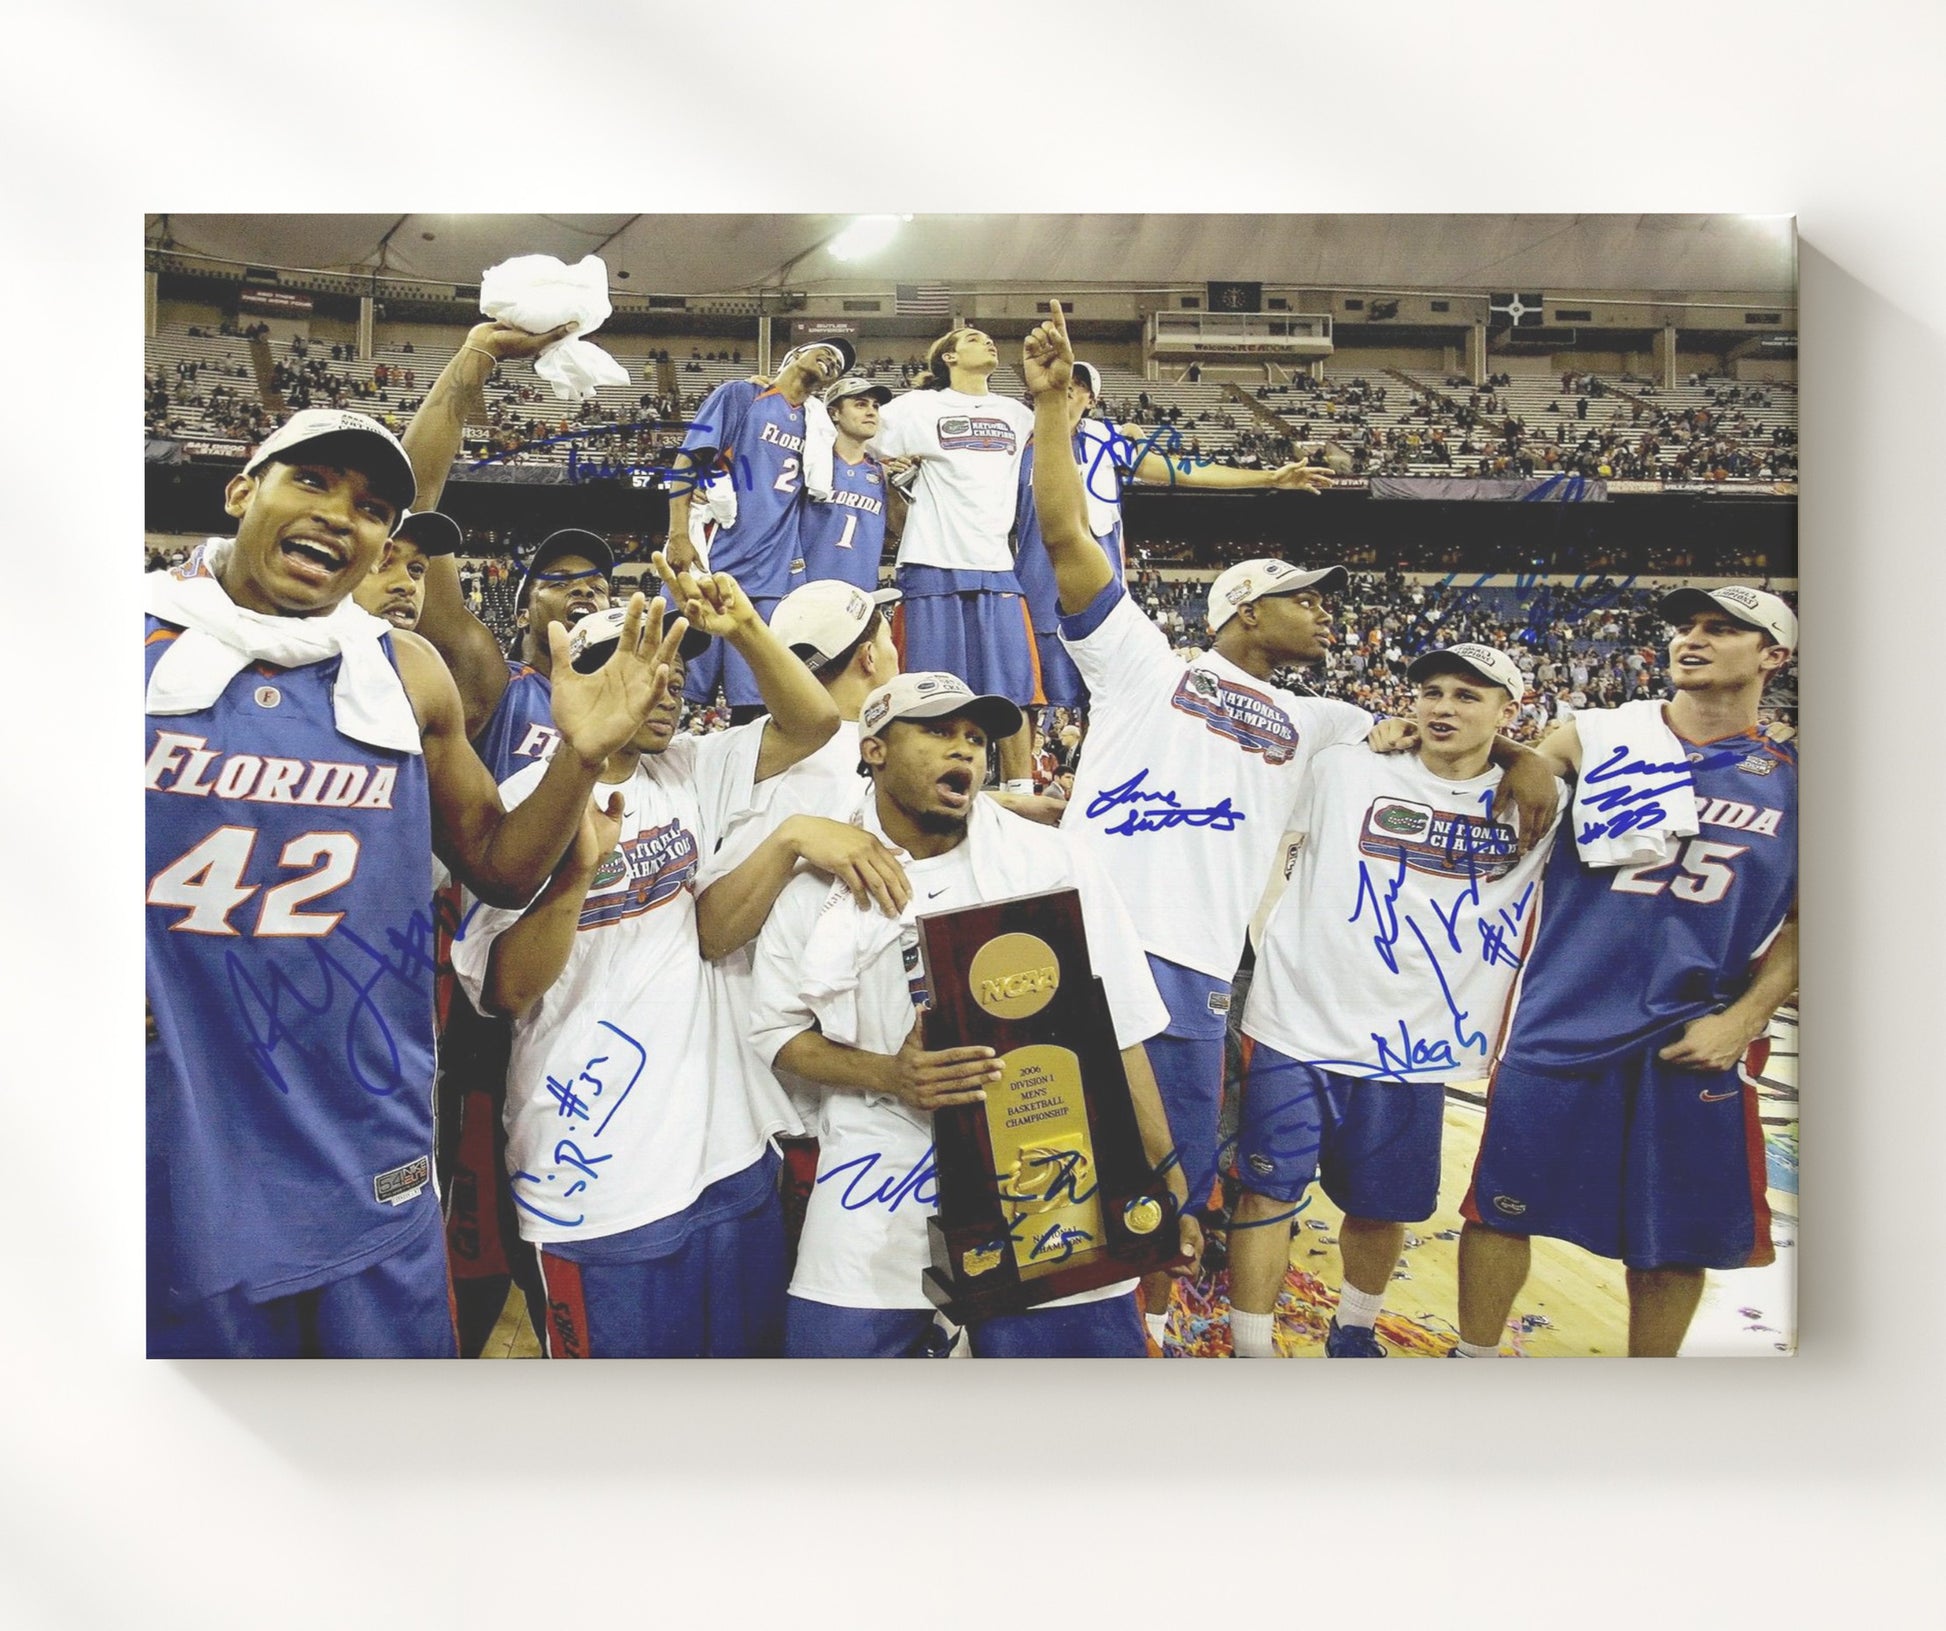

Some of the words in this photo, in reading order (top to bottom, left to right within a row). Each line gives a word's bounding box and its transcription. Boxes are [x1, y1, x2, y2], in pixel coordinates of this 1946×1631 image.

[186, 441, 210, 449] SAN
[760, 422, 806, 454] FLORI
[632, 476, 651, 487] 57
[773, 457, 800, 494] 2
[824, 489, 883, 516] LORIDA
[835, 513, 858, 549] 1
[145, 728, 399, 810] FLORIDA
[146, 824, 361, 938] 42
[1610, 835, 1751, 905] 25
[981, 966, 1059, 1006] NCAA
[1010, 1076, 1048, 1091] DIVISION
[1020, 1066, 1042, 1077] 2006
[1005, 1107, 1069, 1129] CHAMPIONSHIP
[1007, 1096, 1064, 1116] BASKETBALL
